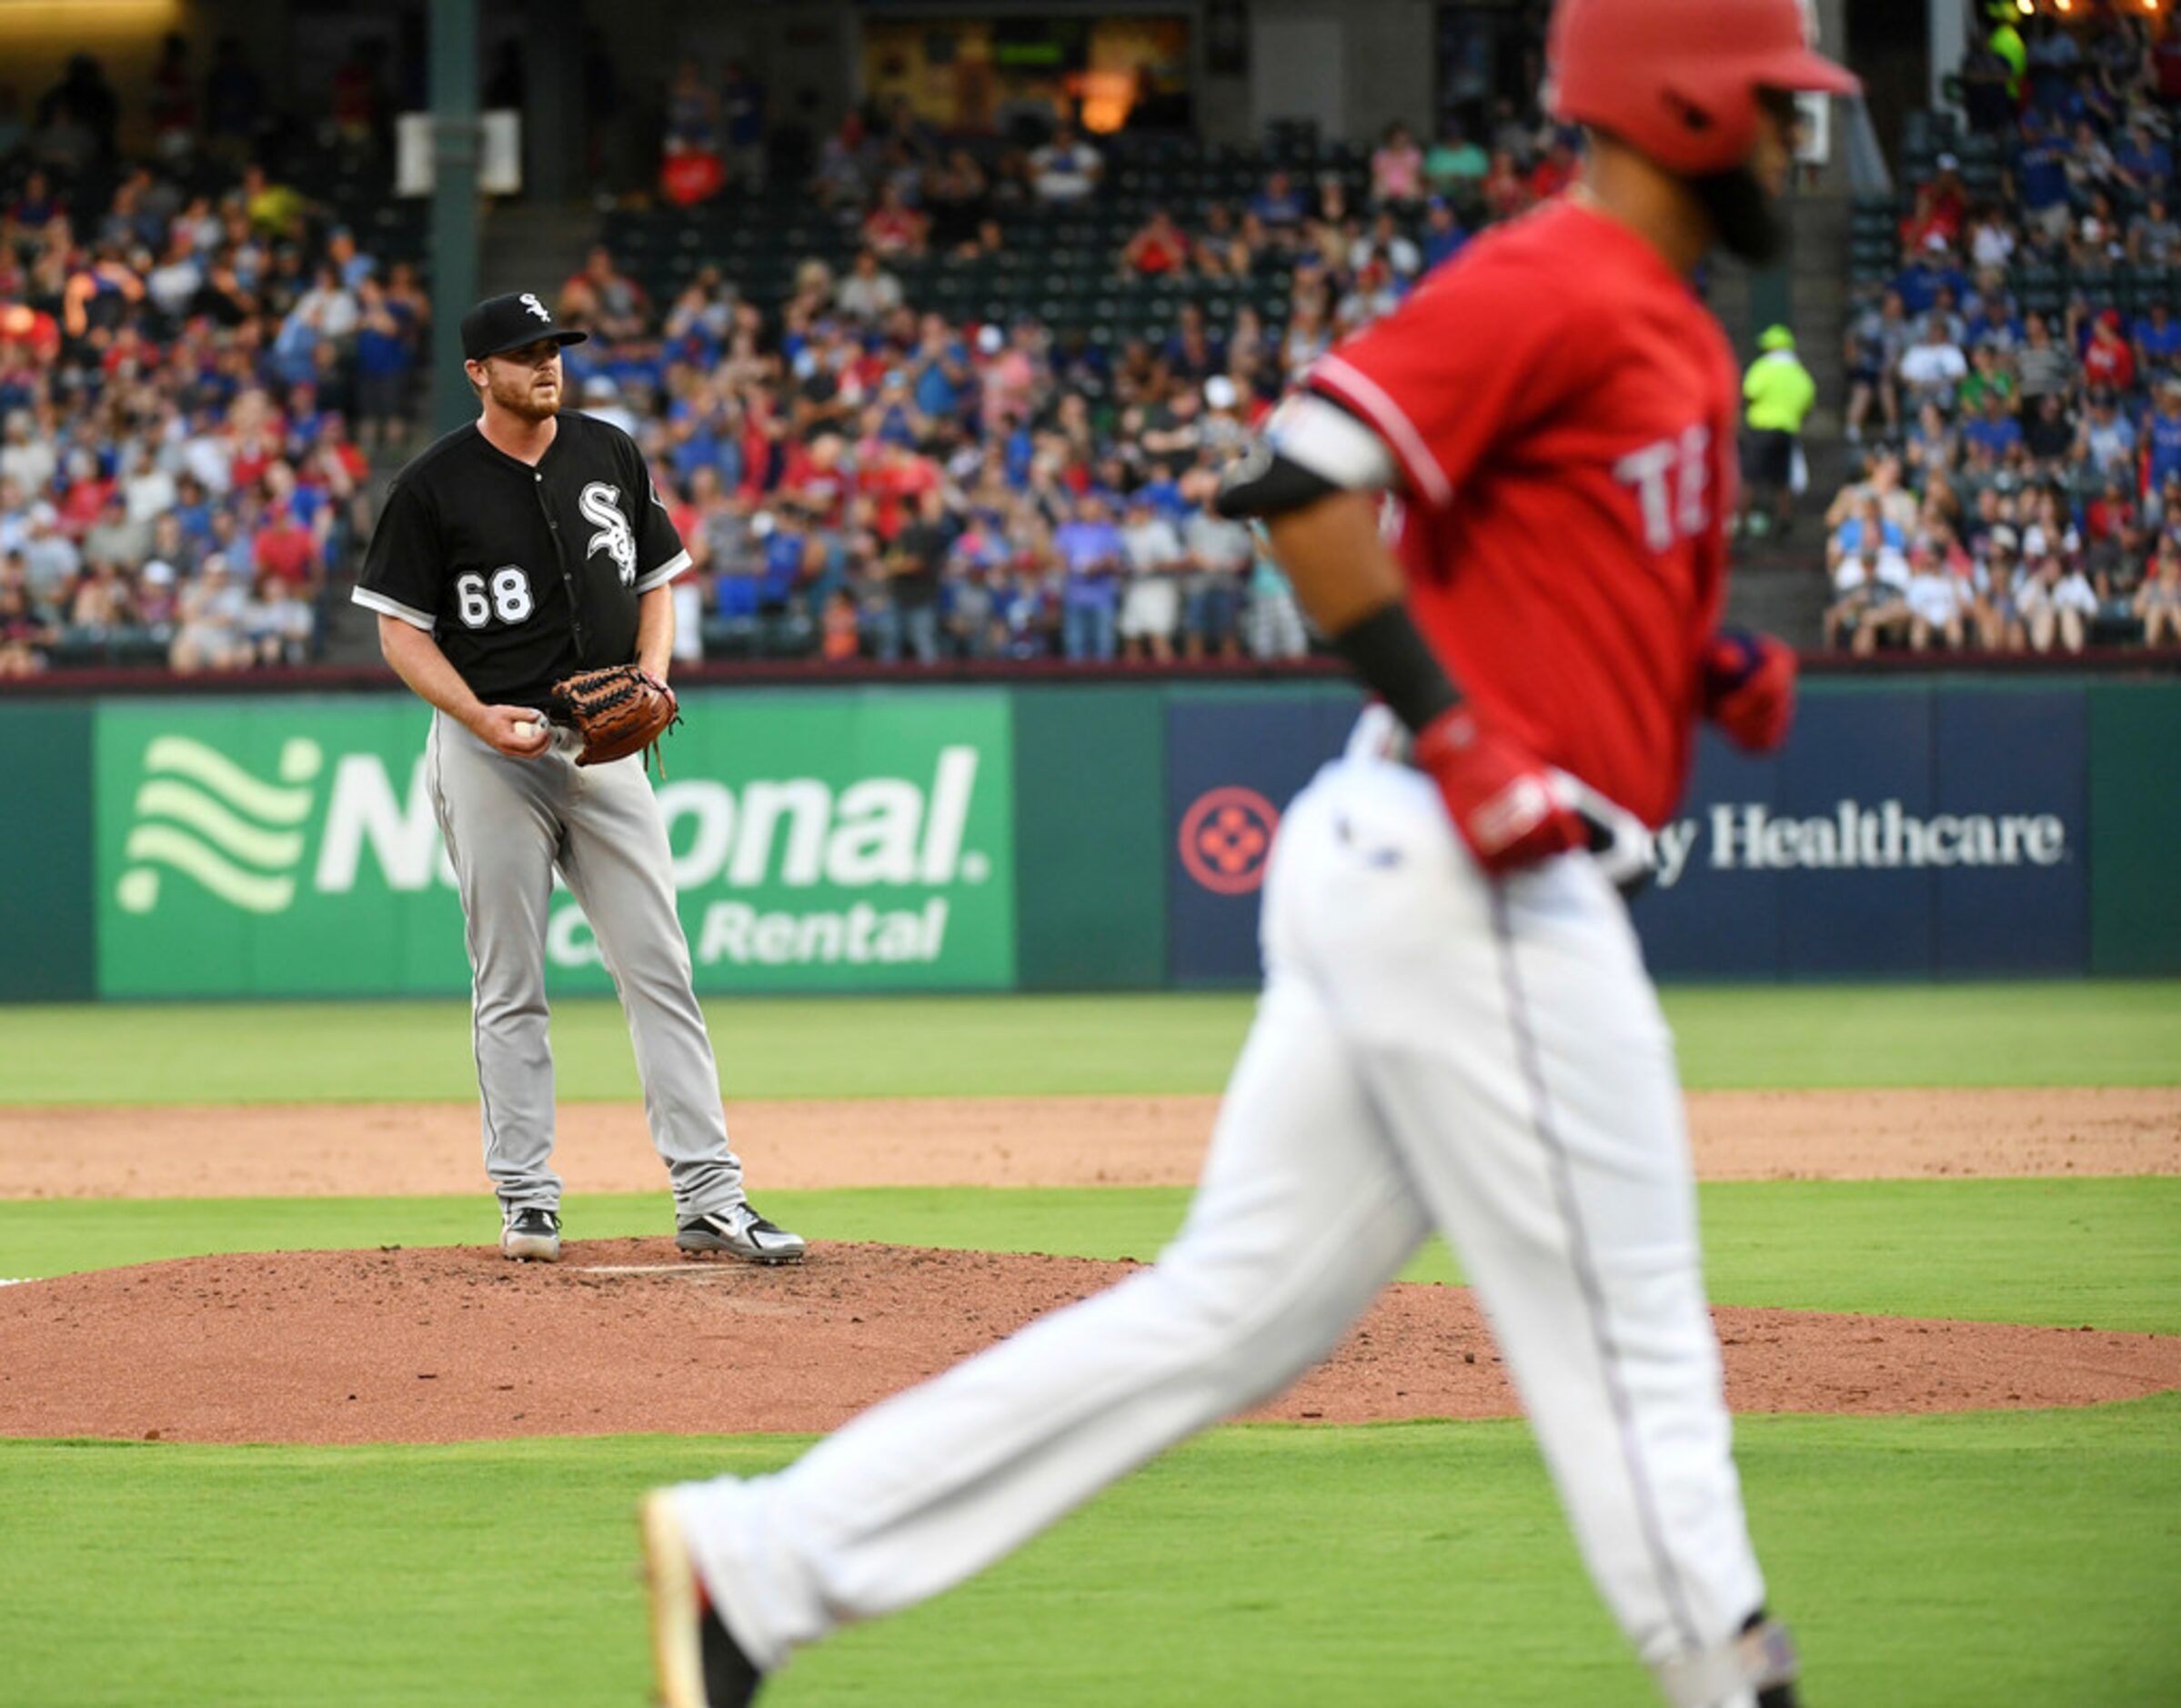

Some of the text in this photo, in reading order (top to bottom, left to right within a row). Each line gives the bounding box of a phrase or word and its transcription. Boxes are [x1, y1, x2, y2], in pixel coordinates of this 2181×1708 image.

[457, 563, 536, 629] 68
[1708, 799, 2065, 869] Healthcare
[697, 896, 949, 966] Rental
